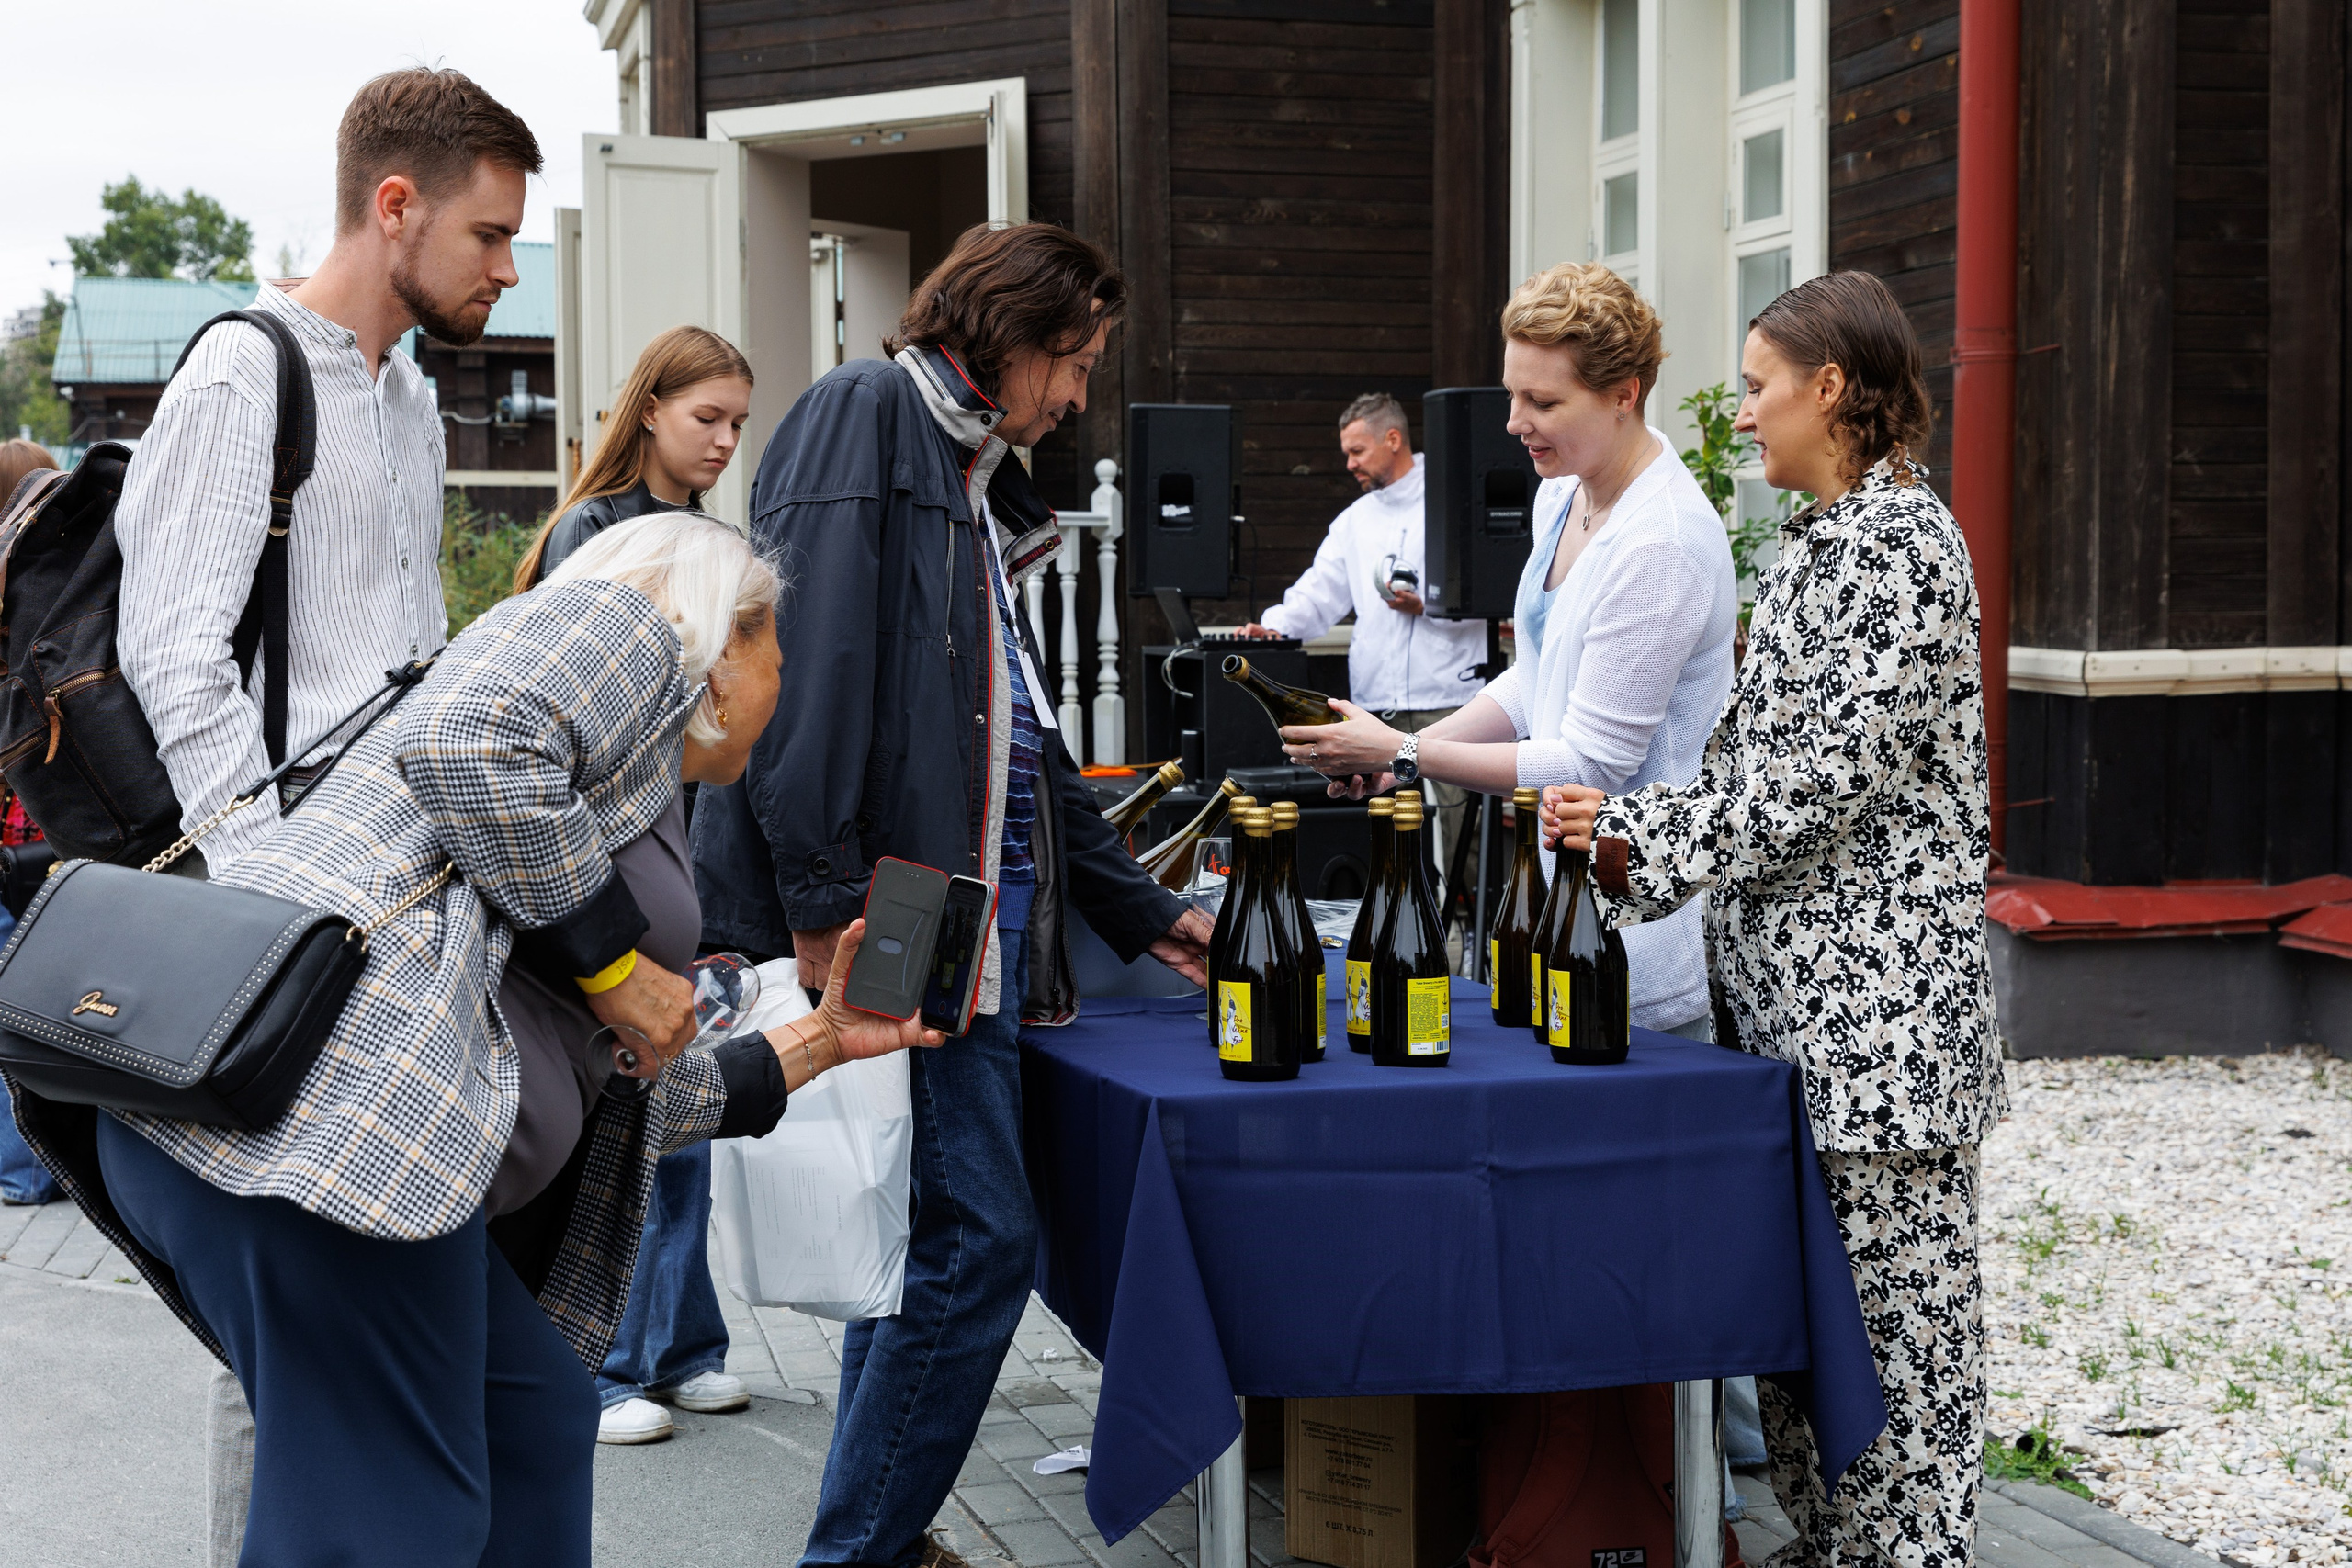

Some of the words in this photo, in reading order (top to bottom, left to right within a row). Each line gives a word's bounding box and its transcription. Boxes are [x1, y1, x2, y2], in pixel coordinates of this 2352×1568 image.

[1233, 1015, 1243, 1023] Pro
[1232, 1025, 1249, 1034] Wine
[1332, 1522, 1344, 1531] ШТ.
[1594, 1552, 1619, 1568] 72
